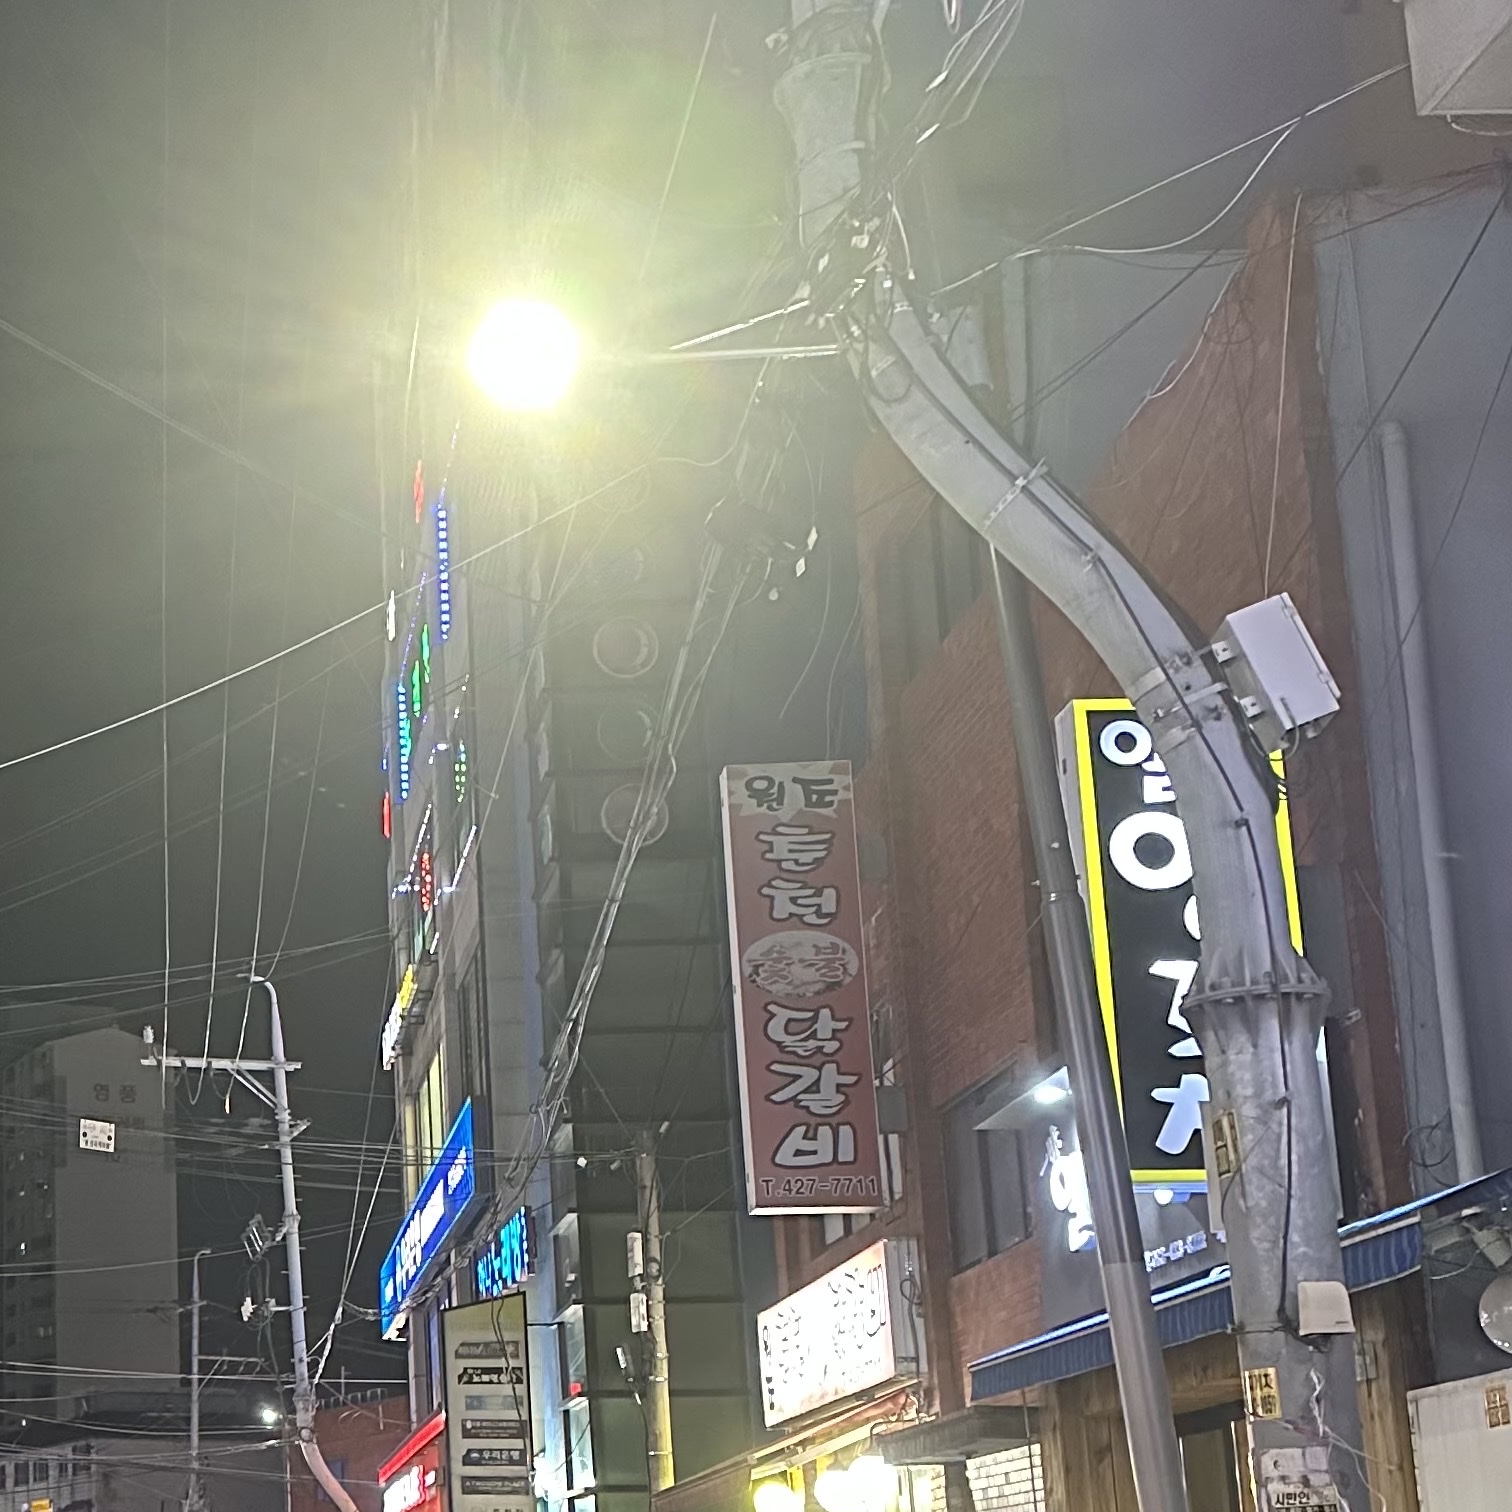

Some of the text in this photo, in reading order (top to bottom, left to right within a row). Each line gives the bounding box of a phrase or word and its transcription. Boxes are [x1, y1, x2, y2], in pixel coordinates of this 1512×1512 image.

[757, 825, 838, 924] 춘천
[766, 1003, 859, 1167] 닭갈비
[761, 1178, 878, 1198] T.427-7711
